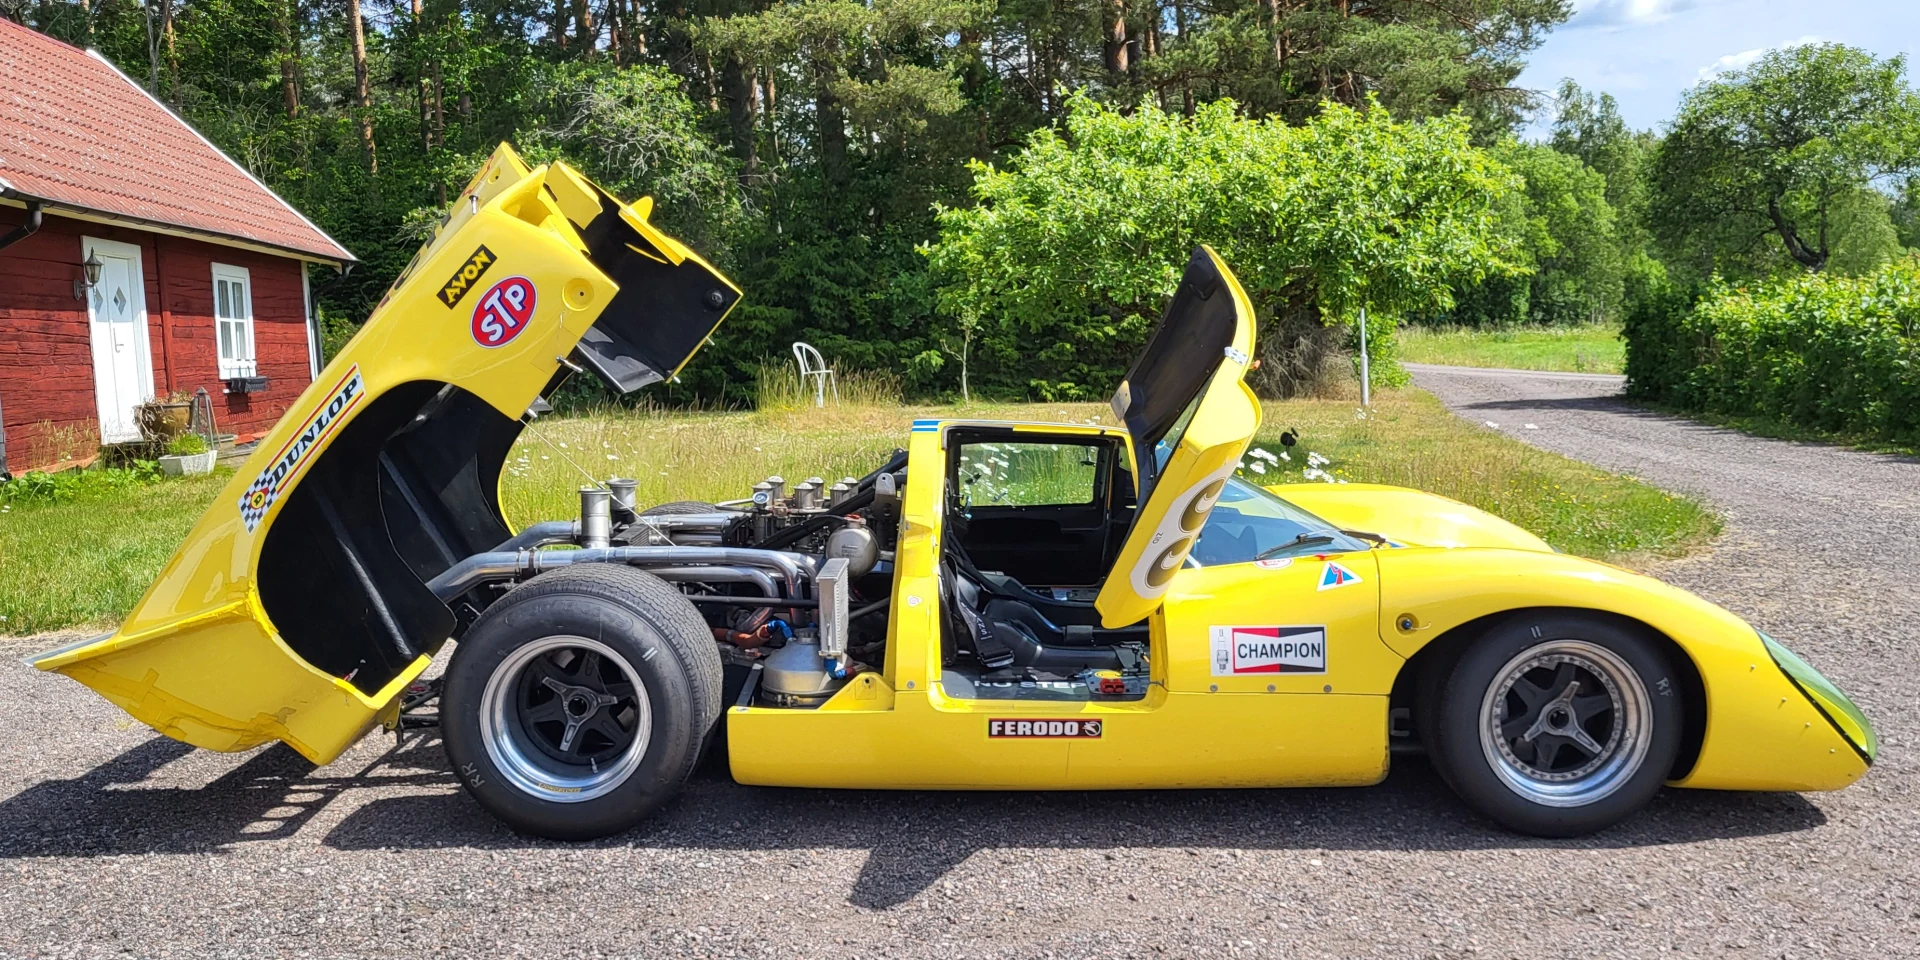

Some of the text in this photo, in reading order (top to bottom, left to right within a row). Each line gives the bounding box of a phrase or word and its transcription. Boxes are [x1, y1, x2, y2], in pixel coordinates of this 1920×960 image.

[445, 250, 491, 304] AVON
[481, 284, 525, 342] STP
[271, 378, 358, 485] DUNLOP
[1237, 643, 1321, 659] CHAMPION
[1656, 676, 1674, 697] RF
[991, 721, 1079, 736] FERODO
[461, 762, 486, 788] RR
